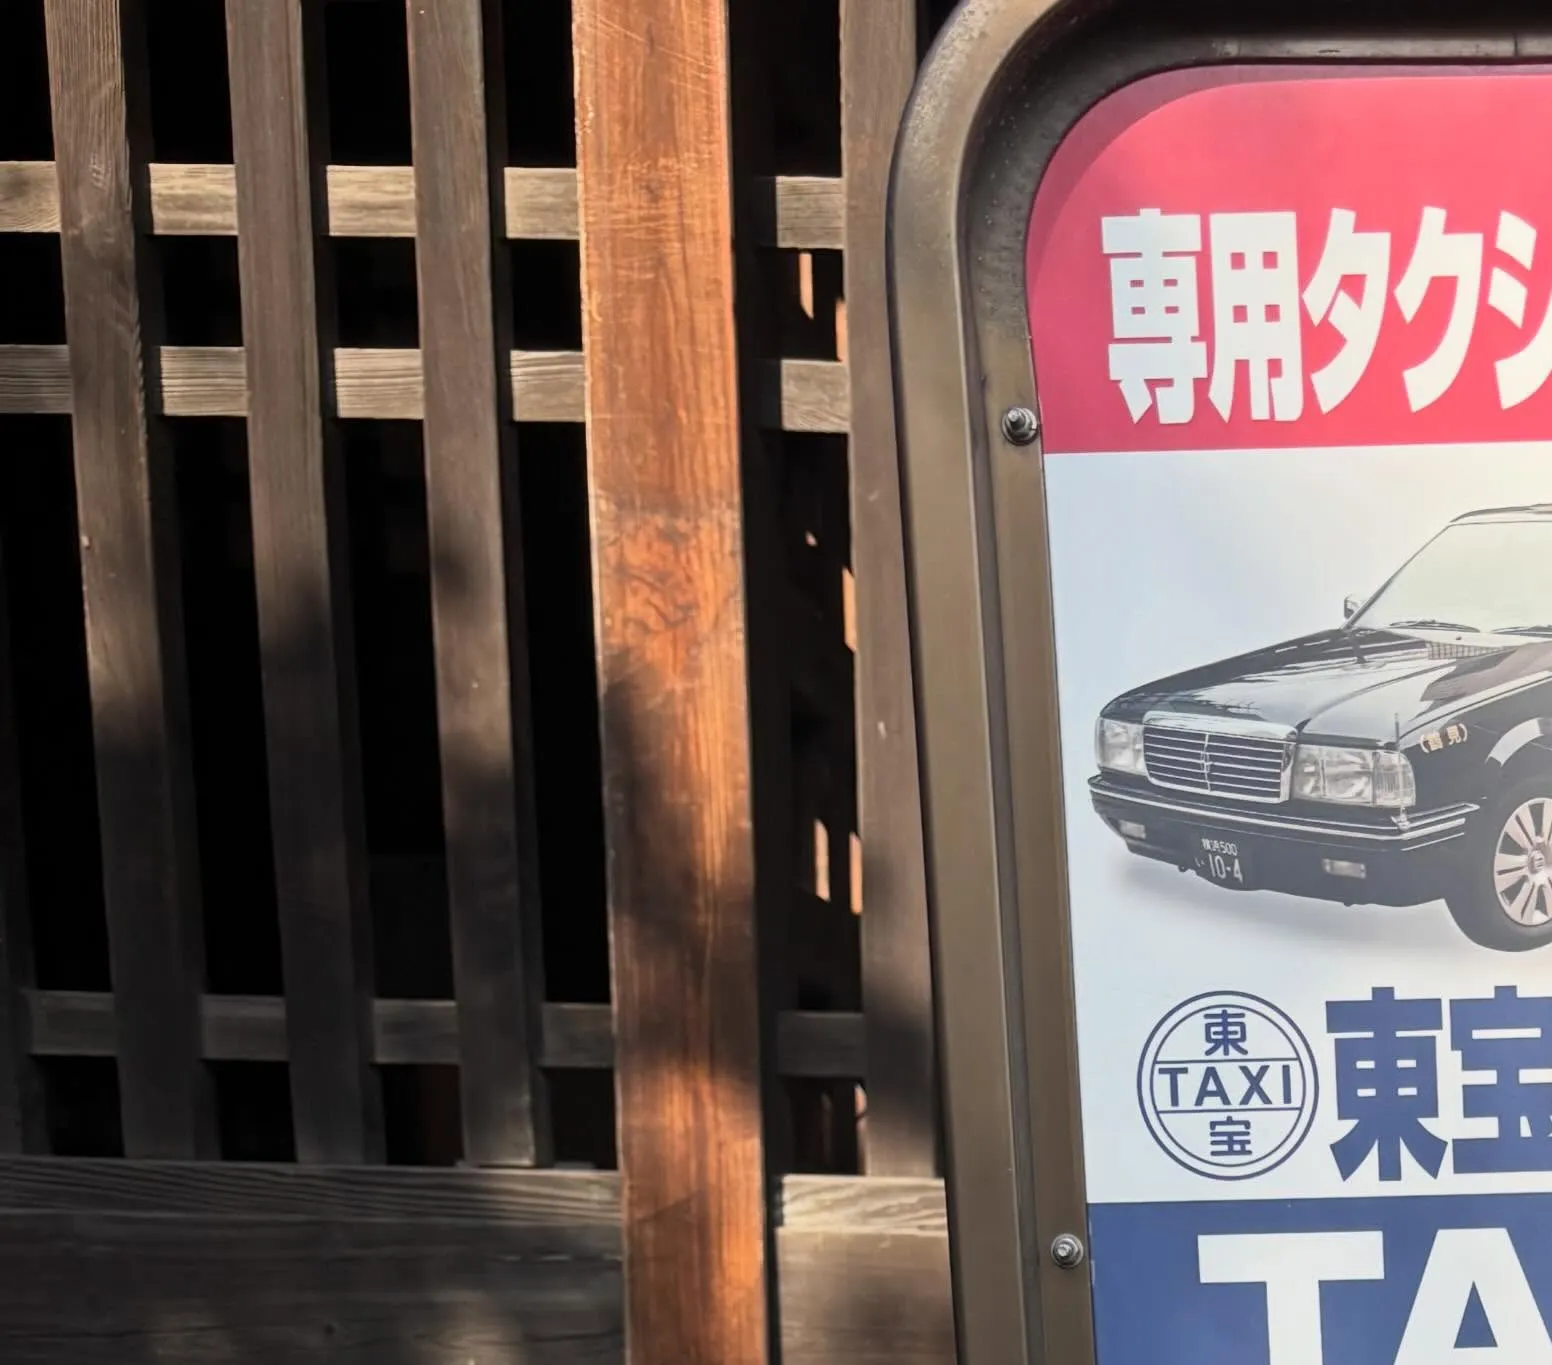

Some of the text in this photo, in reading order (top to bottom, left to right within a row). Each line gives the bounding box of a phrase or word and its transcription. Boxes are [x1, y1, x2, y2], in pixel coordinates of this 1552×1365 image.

[1203, 1009, 1249, 1056] 東
[1158, 1064, 1292, 1108] TAXI
[1209, 1115, 1252, 1156] 宝
